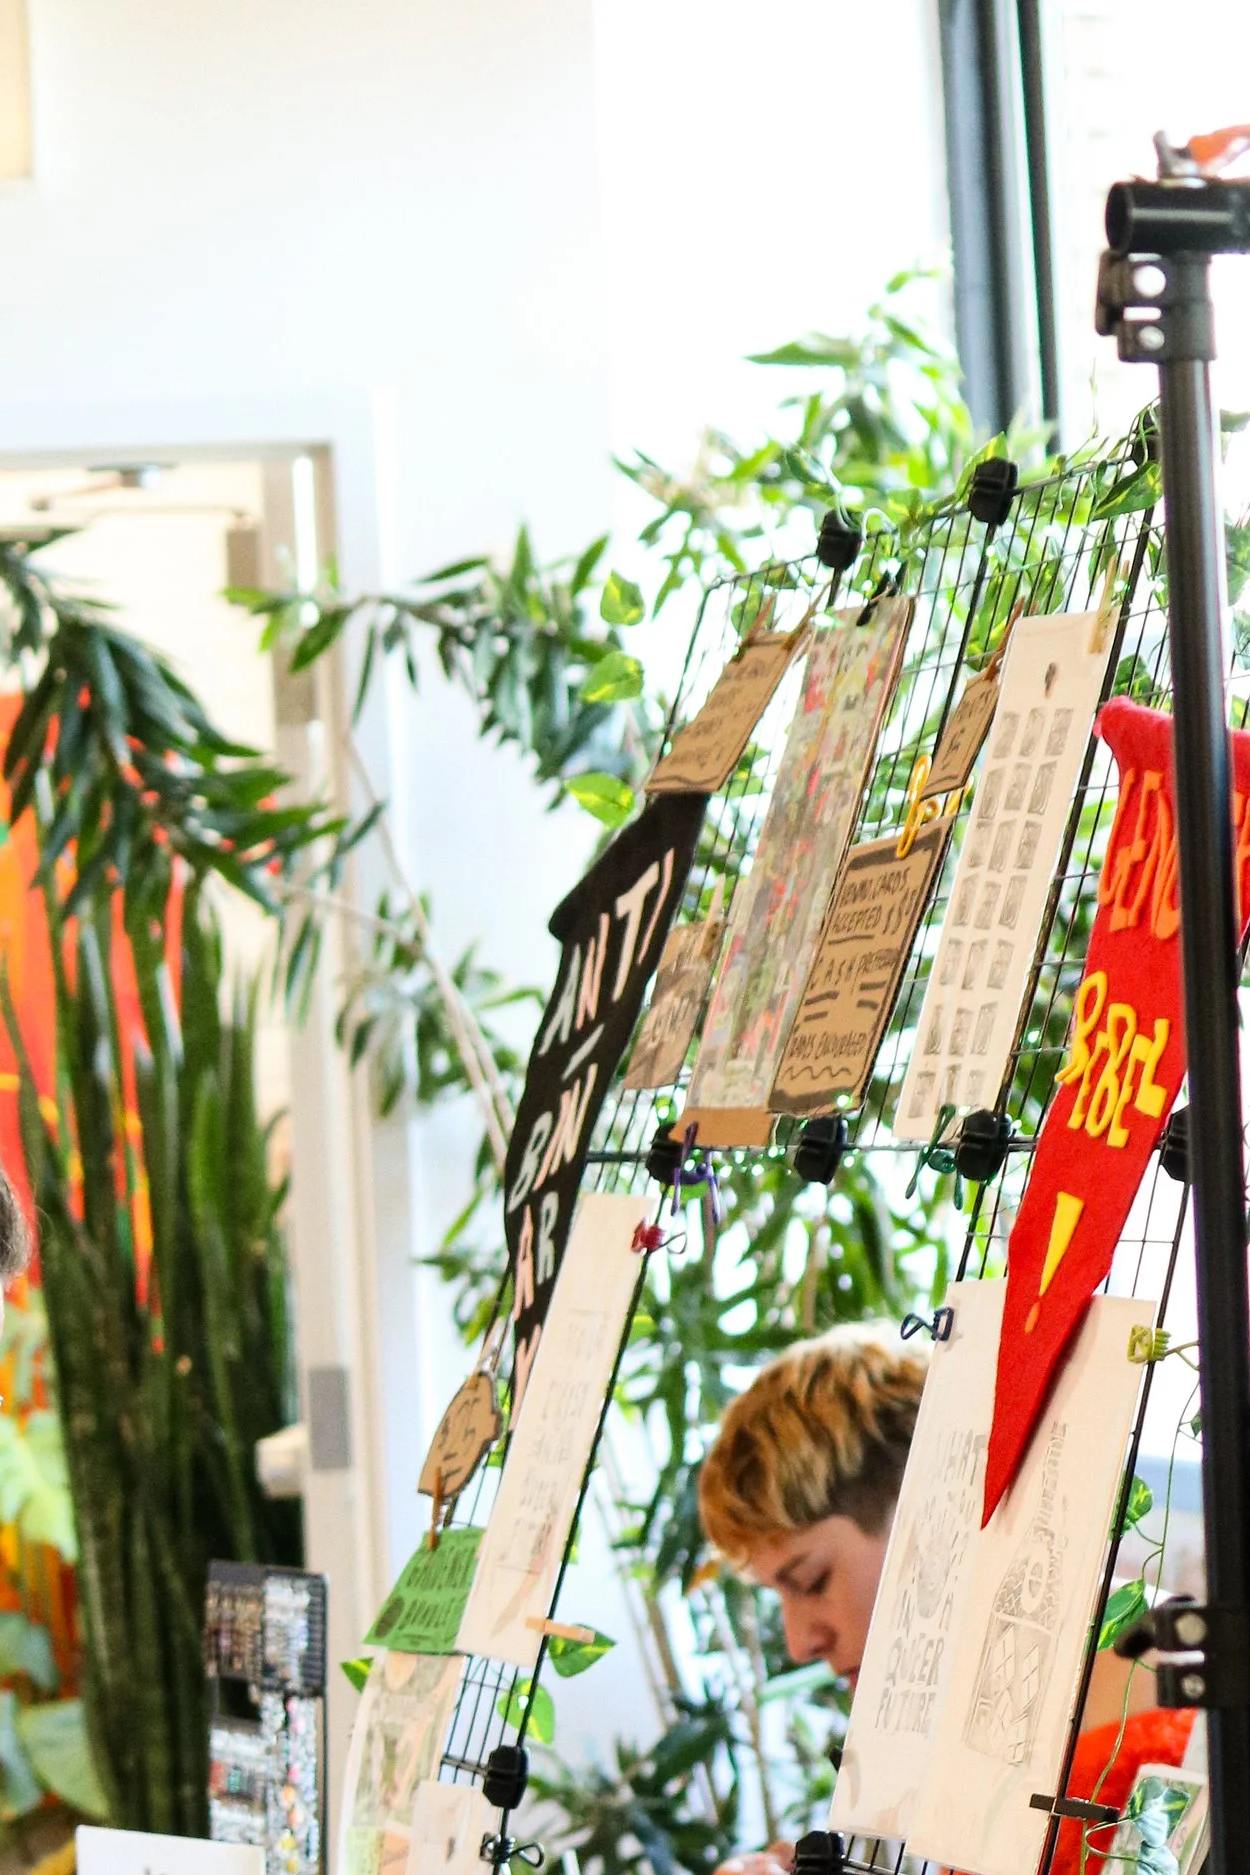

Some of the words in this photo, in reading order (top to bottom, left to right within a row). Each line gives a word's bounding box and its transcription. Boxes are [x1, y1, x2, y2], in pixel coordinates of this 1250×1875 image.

[1055, 970, 1170, 1149] REBEL
[884, 1632, 946, 1687] QUEER
[875, 1685, 938, 1735] FUTURE
